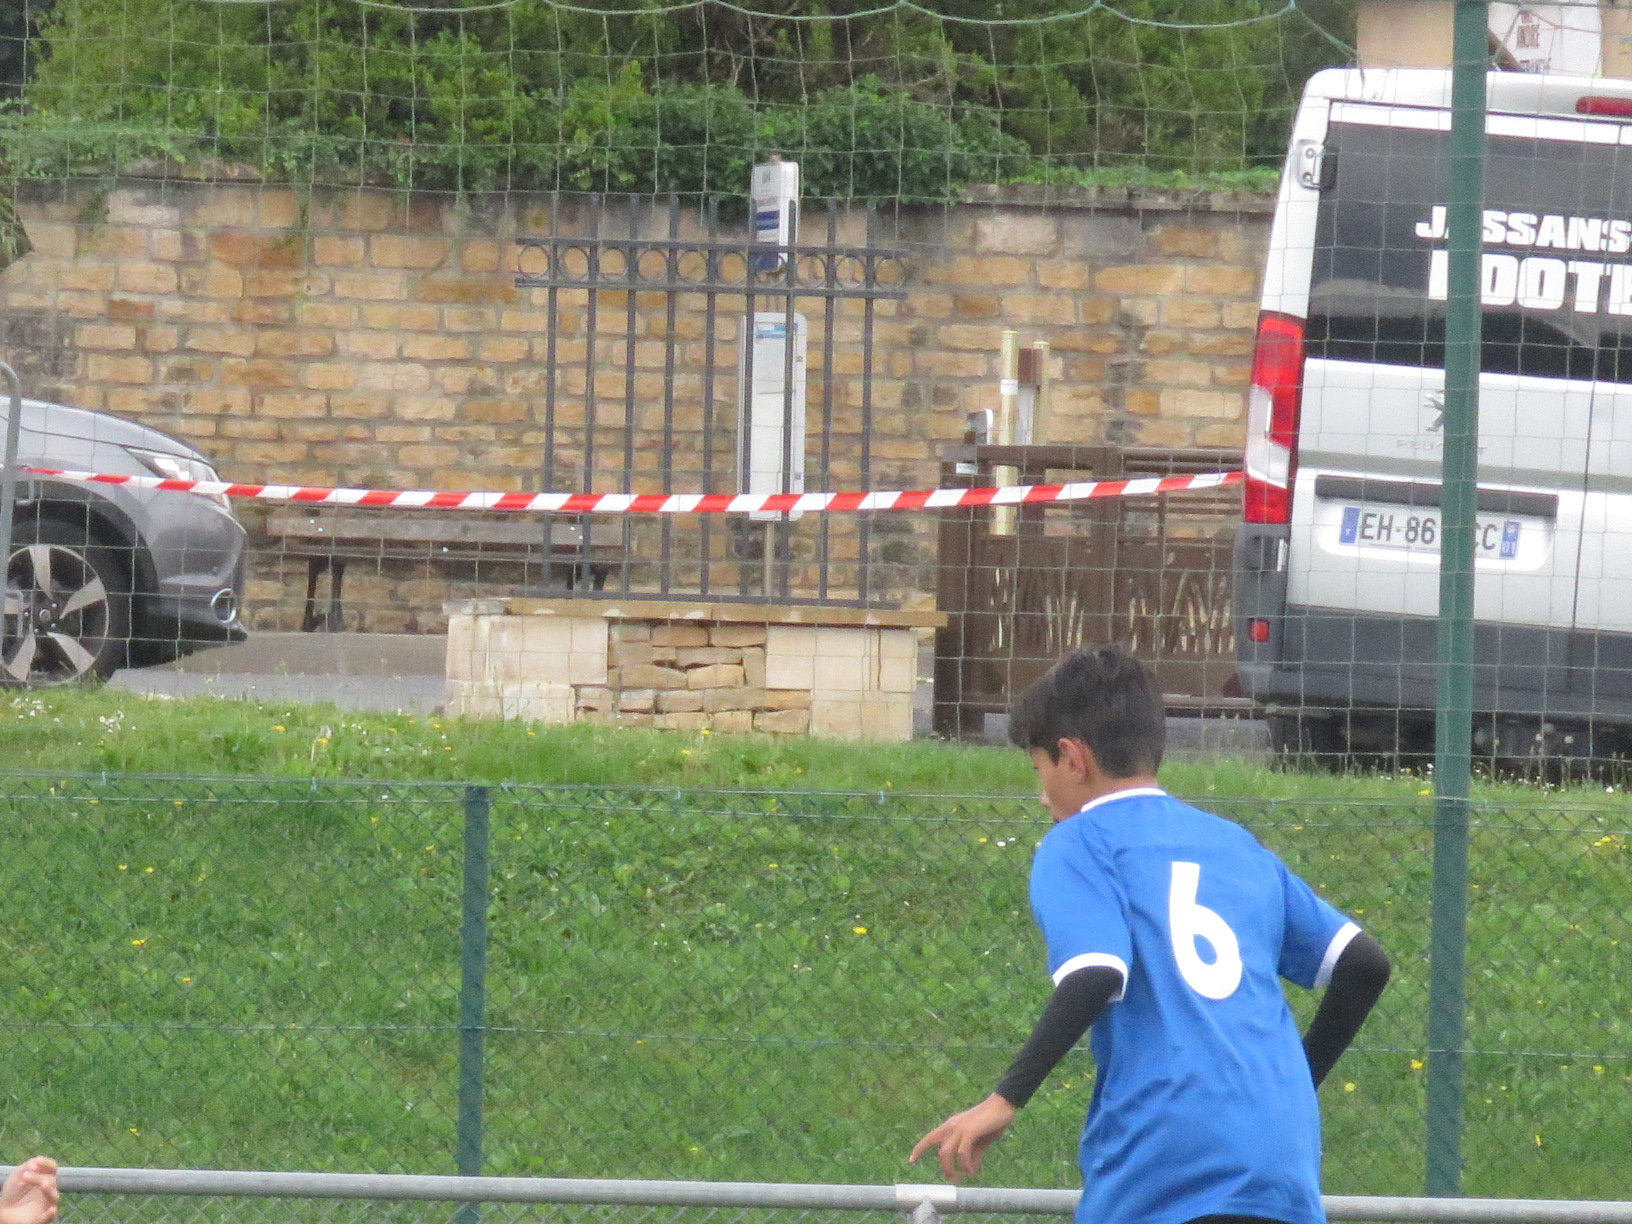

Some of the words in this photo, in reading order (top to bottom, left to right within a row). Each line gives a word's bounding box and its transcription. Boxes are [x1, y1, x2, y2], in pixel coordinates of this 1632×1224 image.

[1416, 205, 1632, 253] JSSANS
[1396, 439, 1488, 456] PEUT
[1169, 860, 1243, 1001] 6
